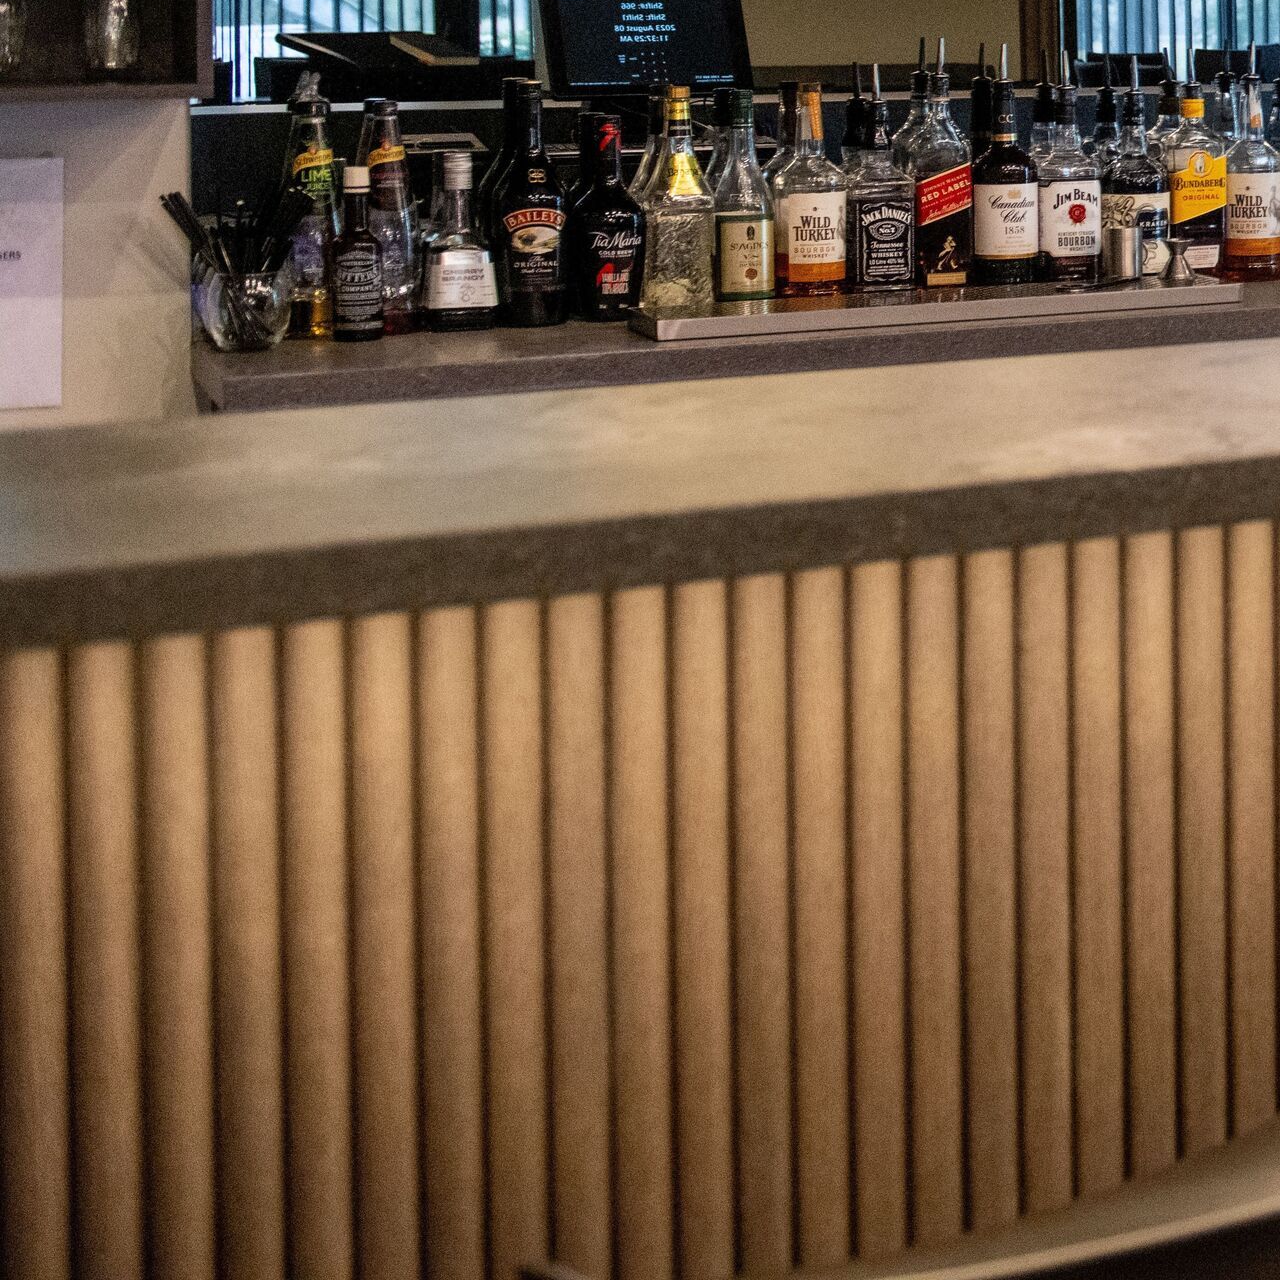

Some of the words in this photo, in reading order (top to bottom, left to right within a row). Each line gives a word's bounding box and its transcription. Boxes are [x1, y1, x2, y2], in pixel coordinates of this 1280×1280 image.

[998, 113, 1014, 124] CC
[301, 169, 332, 182] LIME
[1173, 176, 1226, 190] BUNDABERG
[921, 191, 940, 203] RED
[942, 179, 971, 196] LABEL
[988, 194, 1035, 209] Canadian
[1053, 192, 1072, 209] JIM
[1073, 188, 1098, 207] BEAM
[1234, 194, 1263, 206] WILD
[860, 209, 882, 226] JACK
[881, 206, 912, 225] DANIEL'S
[1000, 209, 1025, 224] Club
[1228, 203, 1268, 219] TURKEY
[507, 210, 563, 227] BAILEYS
[799, 215, 831, 229] WILD
[792, 226, 837, 242] TURKEY
[1004, 226, 1025, 235] 1858
[588, 231, 609, 249] Tia
[606, 231, 642, 249] Maria
[870, 240, 904, 249] Tennessee
[1058, 236, 1096, 247] BOURBON
[793, 246, 836, 254] BOURBON
[513, 260, 559, 268] ORIGINAL
